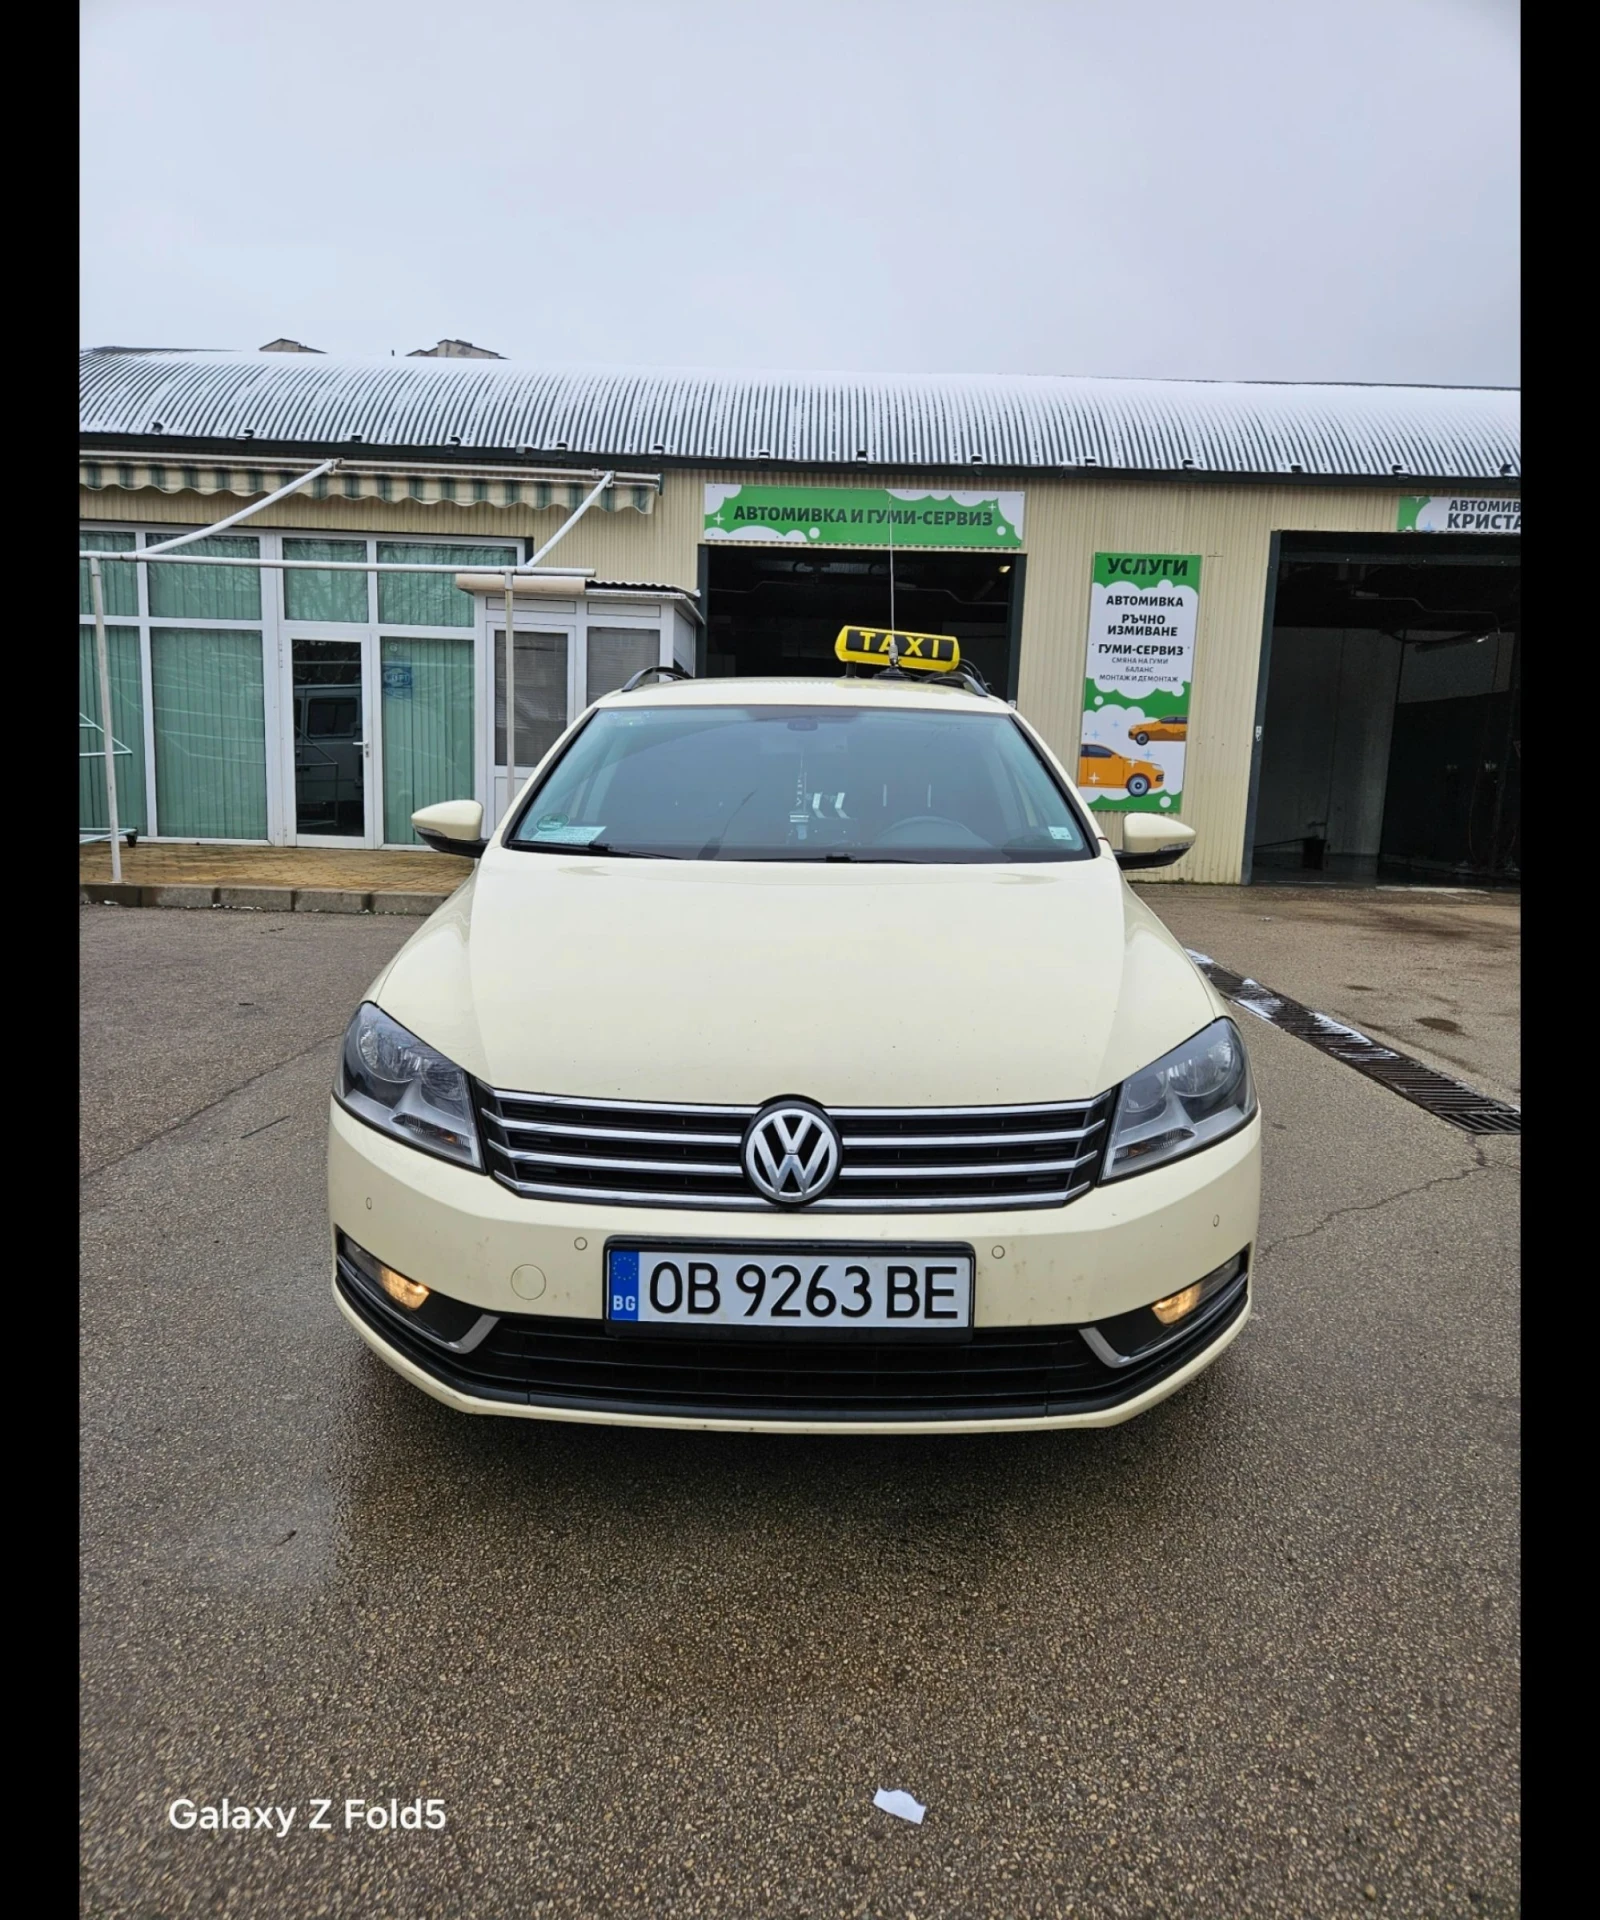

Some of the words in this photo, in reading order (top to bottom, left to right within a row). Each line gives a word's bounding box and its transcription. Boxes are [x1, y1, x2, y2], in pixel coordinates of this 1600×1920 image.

[1448, 500, 1521, 512] АВТОМИВ
[734, 506, 847, 523] АВТОМИВКА
[851, 509, 864, 523] И
[867, 509, 993, 526] ГУМИ-СЕРВИЗ
[1107, 558, 1188, 576] УСЛУГИ
[1106, 595, 1184, 607] АВТОМИВКА
[1121, 614, 1165, 625] РЪЧНО
[1107, 625, 1178, 636] ИЗМИВАНЕ
[860, 631, 939, 658] TAXI
[1098, 644, 1184, 656] ГУМИ-СЕРВИЗ
[650, 1261, 721, 1315] OB
[736, 1264, 872, 1318] 9263
[886, 1265, 958, 1319] BE
[613, 1295, 636, 1312] BG
